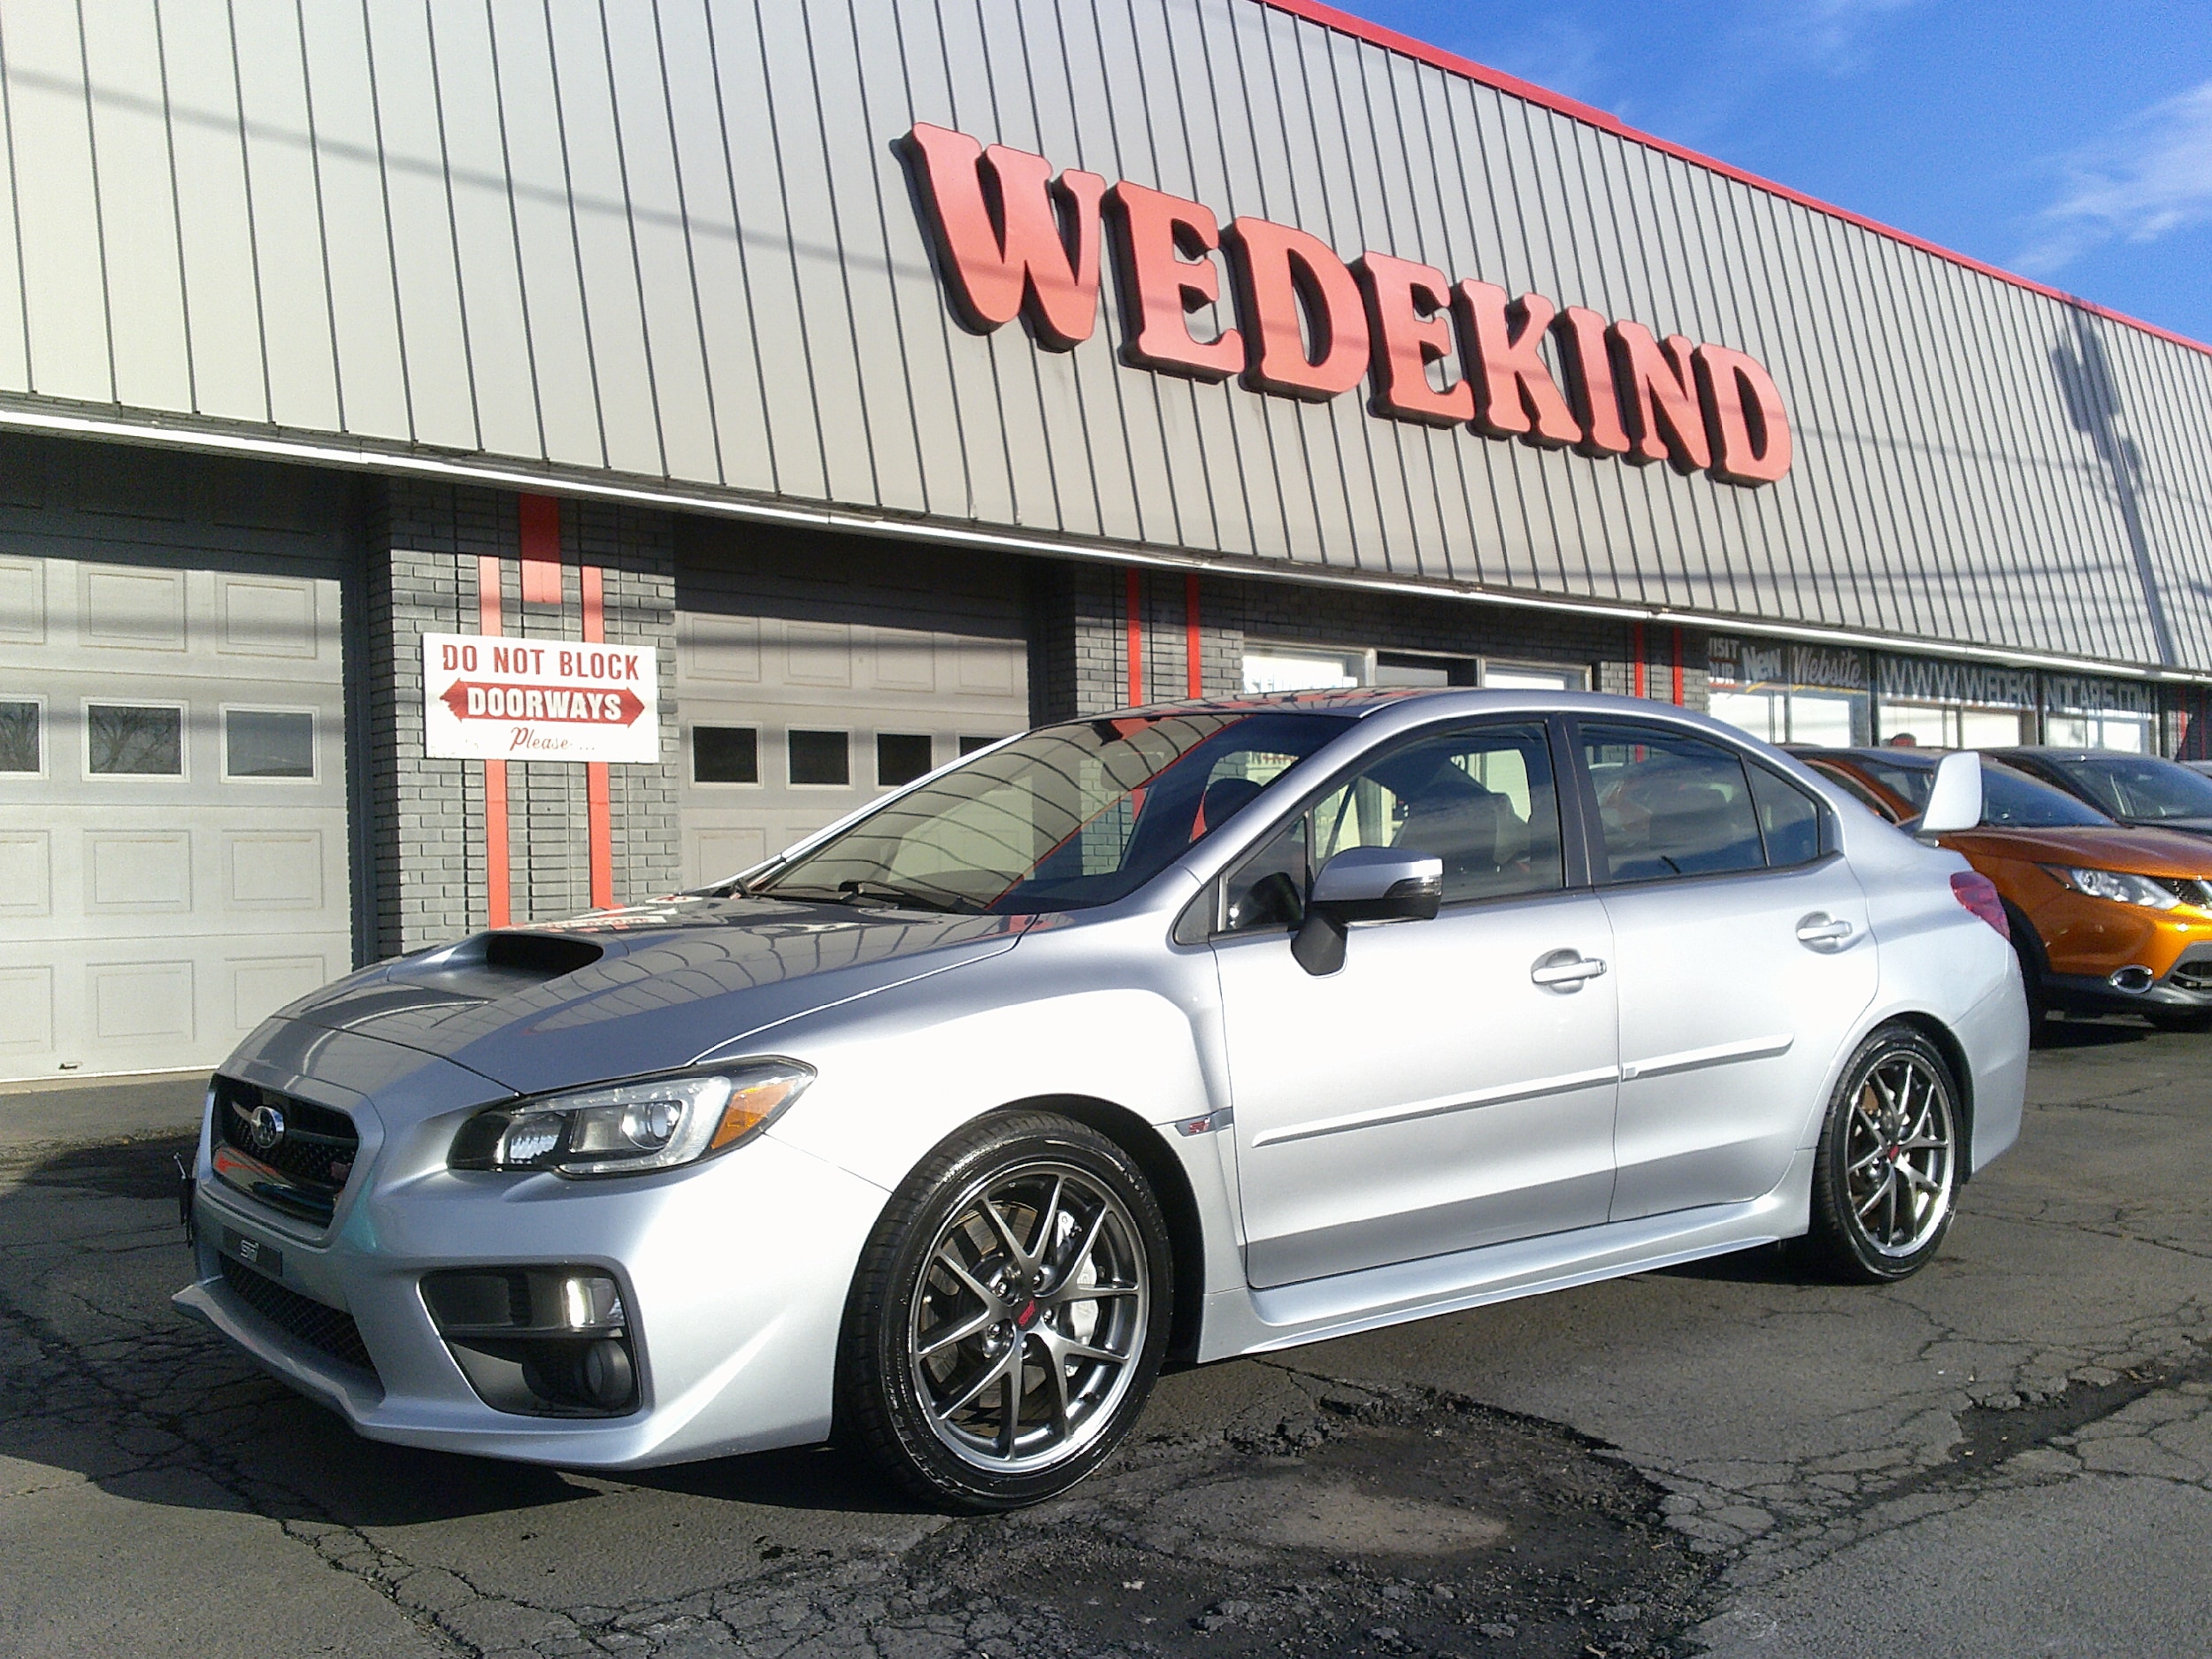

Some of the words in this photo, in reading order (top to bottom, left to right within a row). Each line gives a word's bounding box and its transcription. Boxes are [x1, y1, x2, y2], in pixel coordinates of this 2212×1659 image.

[901, 122, 1793, 486] WEDEKIND
[442, 644, 478, 672] DO
[493, 646, 545, 675] NOT
[559, 650, 639, 680] BLOCK
[1793, 646, 1861, 687] Website
[467, 687, 621, 721] DOORWAYS
[510, 726, 571, 751] Please
